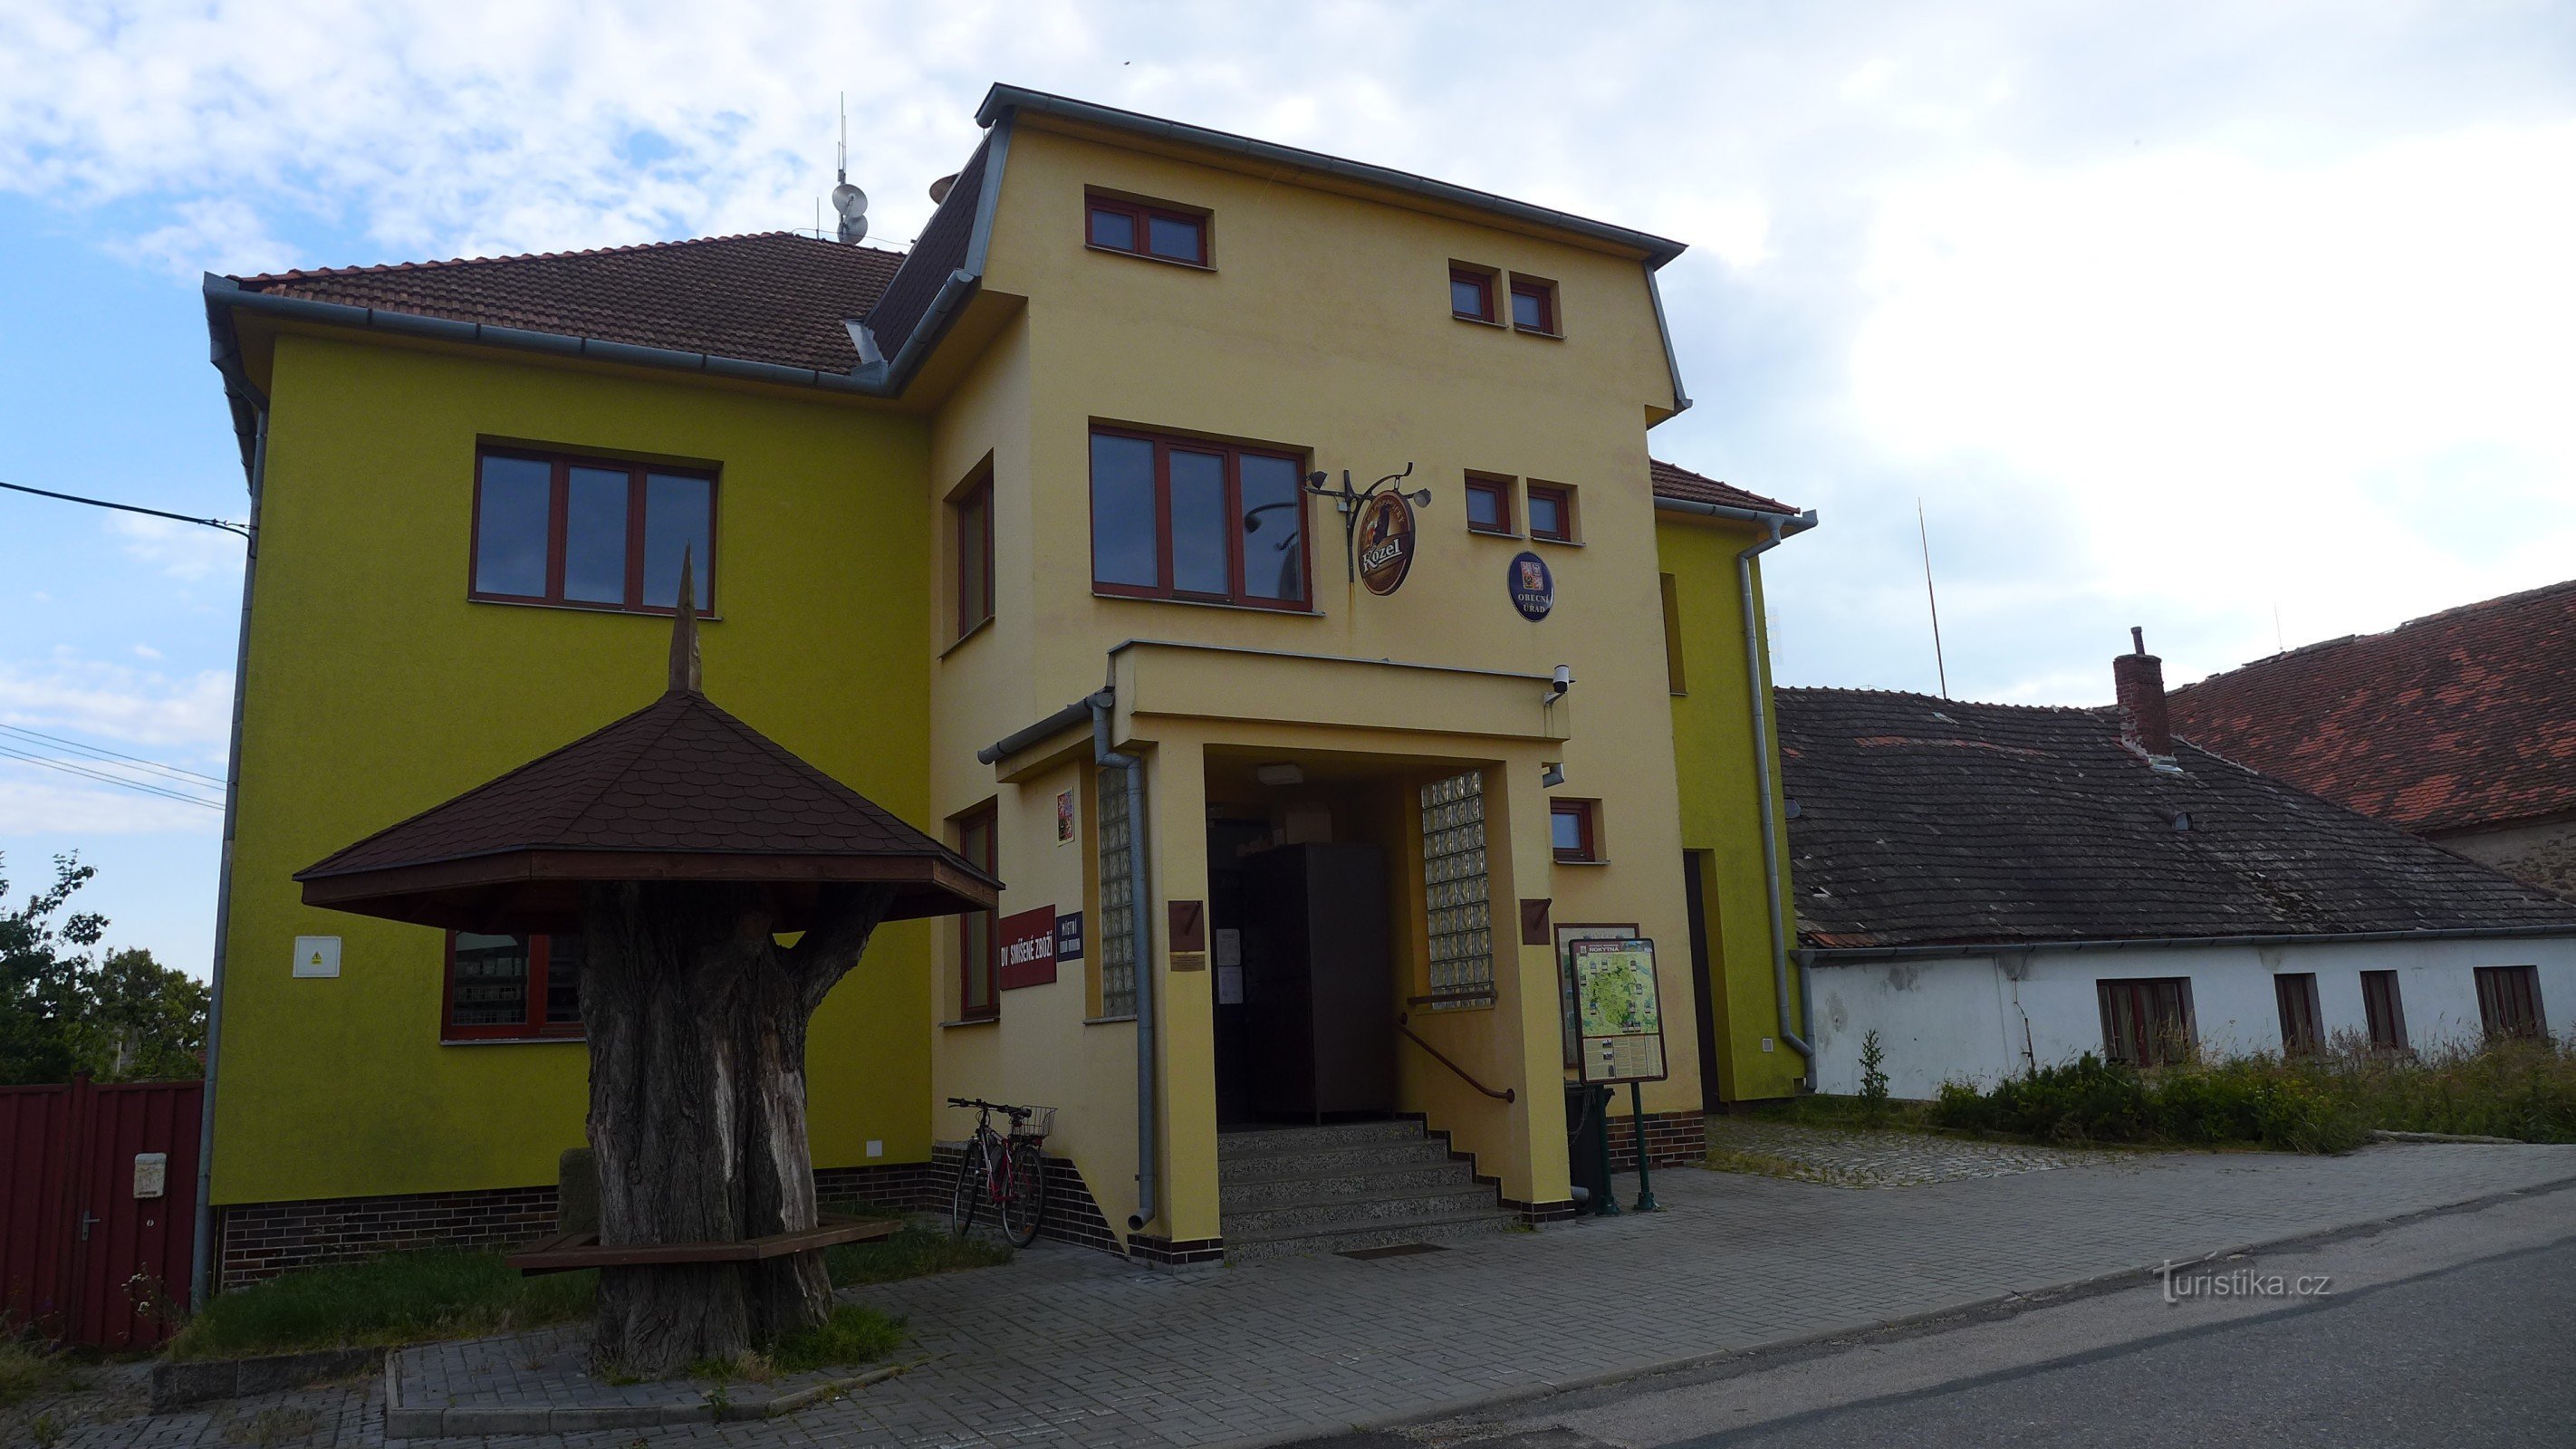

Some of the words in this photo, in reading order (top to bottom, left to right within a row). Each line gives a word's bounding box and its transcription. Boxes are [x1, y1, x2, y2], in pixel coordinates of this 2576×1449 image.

[1362, 538, 1402, 572] Kozel
[1518, 593, 1550, 604] OBECNÍ
[1523, 602, 1545, 613] ÚŘAD
[1010, 935, 1034, 965] SMÍŠENÉ
[1034, 930, 1053, 959] ZBOŽÍ
